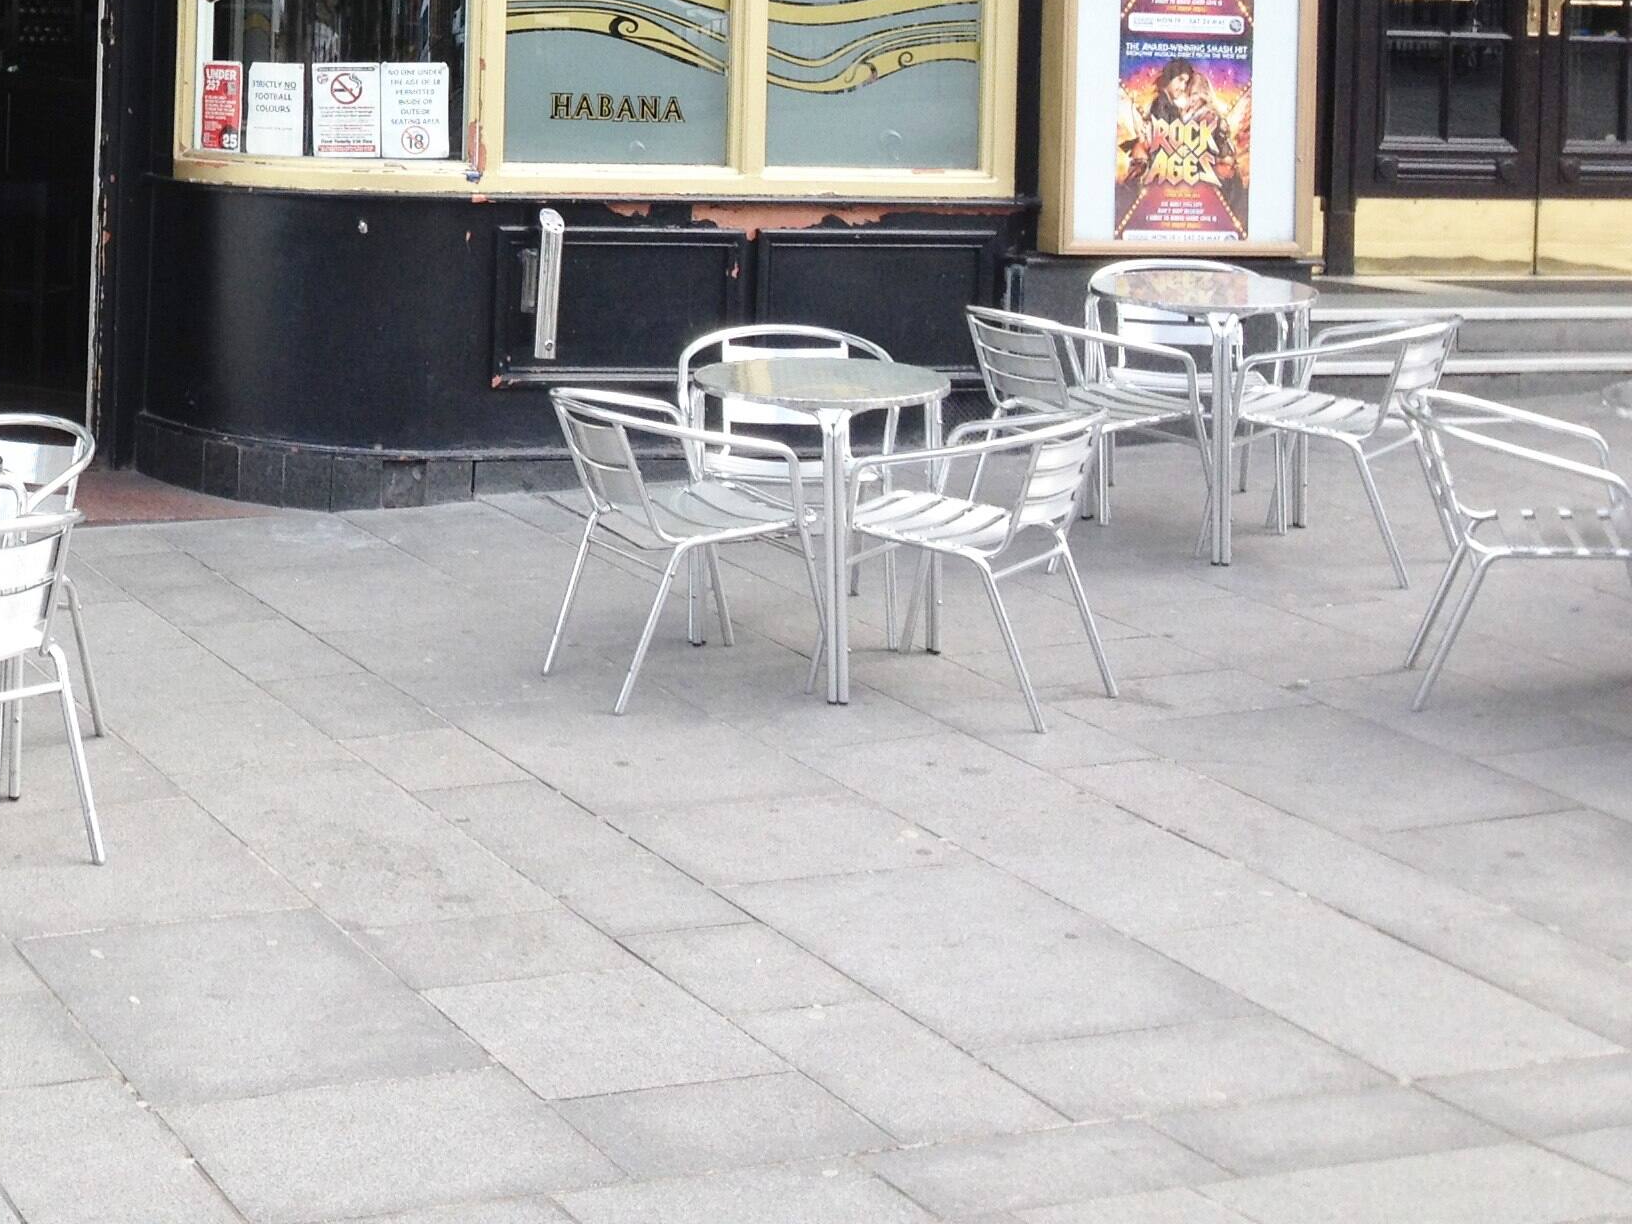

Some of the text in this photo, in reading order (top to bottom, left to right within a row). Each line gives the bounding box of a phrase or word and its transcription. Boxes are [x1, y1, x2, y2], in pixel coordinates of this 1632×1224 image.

[205, 68, 237, 81] UNDER
[284, 81, 297, 89] NO
[255, 92, 293, 101] FOOTBALL
[255, 105, 291, 113] COLOURS
[550, 92, 685, 123] HABANA
[222, 134, 239, 149] 25
[1149, 114, 1220, 154] ROCK
[406, 134, 425, 150] 18
[1144, 149, 1222, 187] AGES
